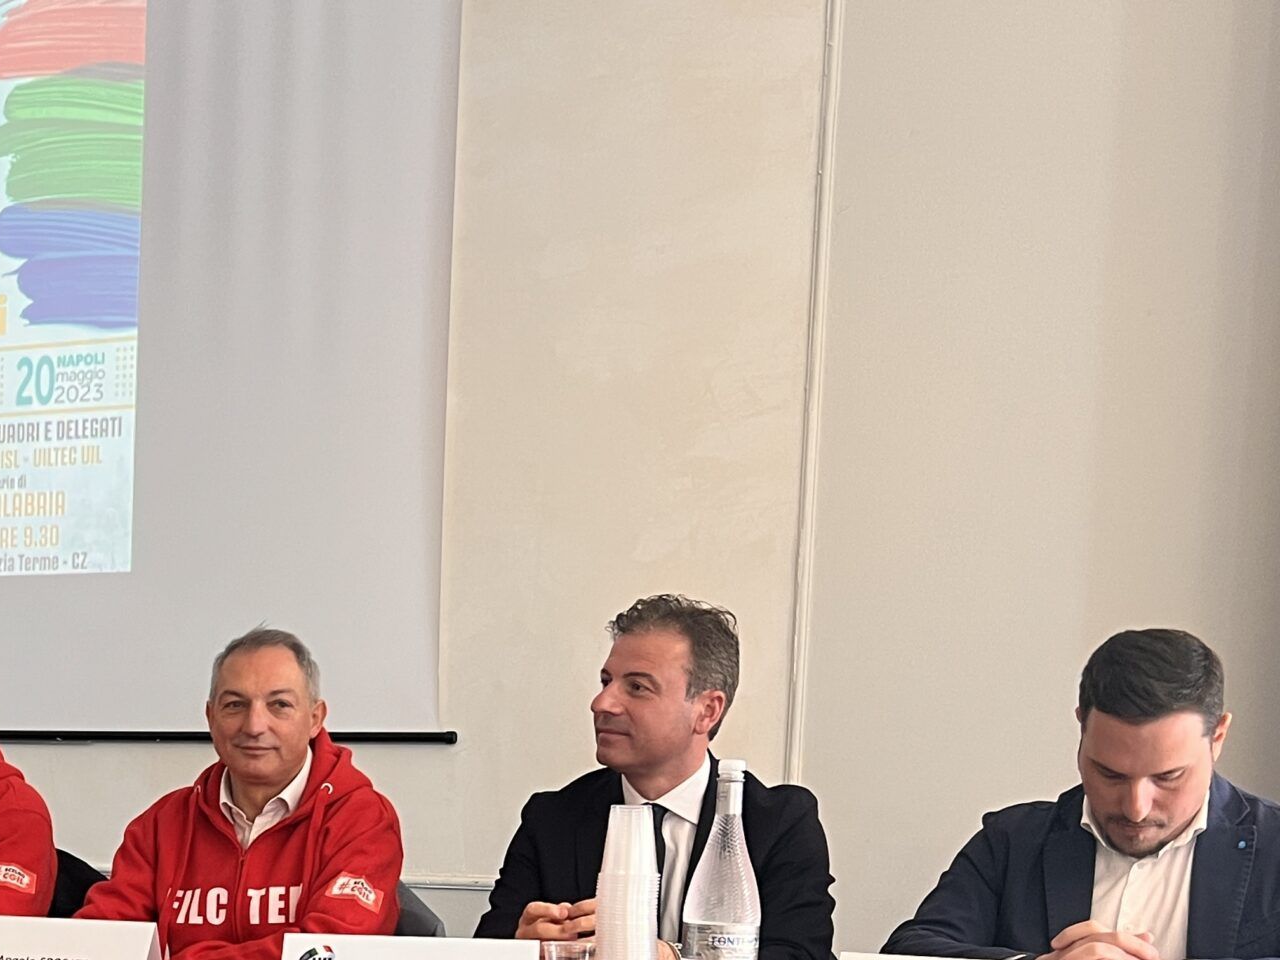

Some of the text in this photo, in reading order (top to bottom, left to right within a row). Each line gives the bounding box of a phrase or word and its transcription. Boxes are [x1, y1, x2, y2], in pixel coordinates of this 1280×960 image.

[57, 352, 105, 367] NAPOLI
[16, 355, 55, 406] 20
[56, 366, 106, 386] maggio
[54, 383, 104, 404] 2023
[44, 421, 53, 441] E
[56, 416, 122, 441] DELEGATI
[33, 446, 77, 468] UILTEC
[81, 445, 102, 465] UIL
[23, 525, 60, 548] 9.30
[18, 553, 59, 572] Terme
[72, 552, 88, 570] CZ
